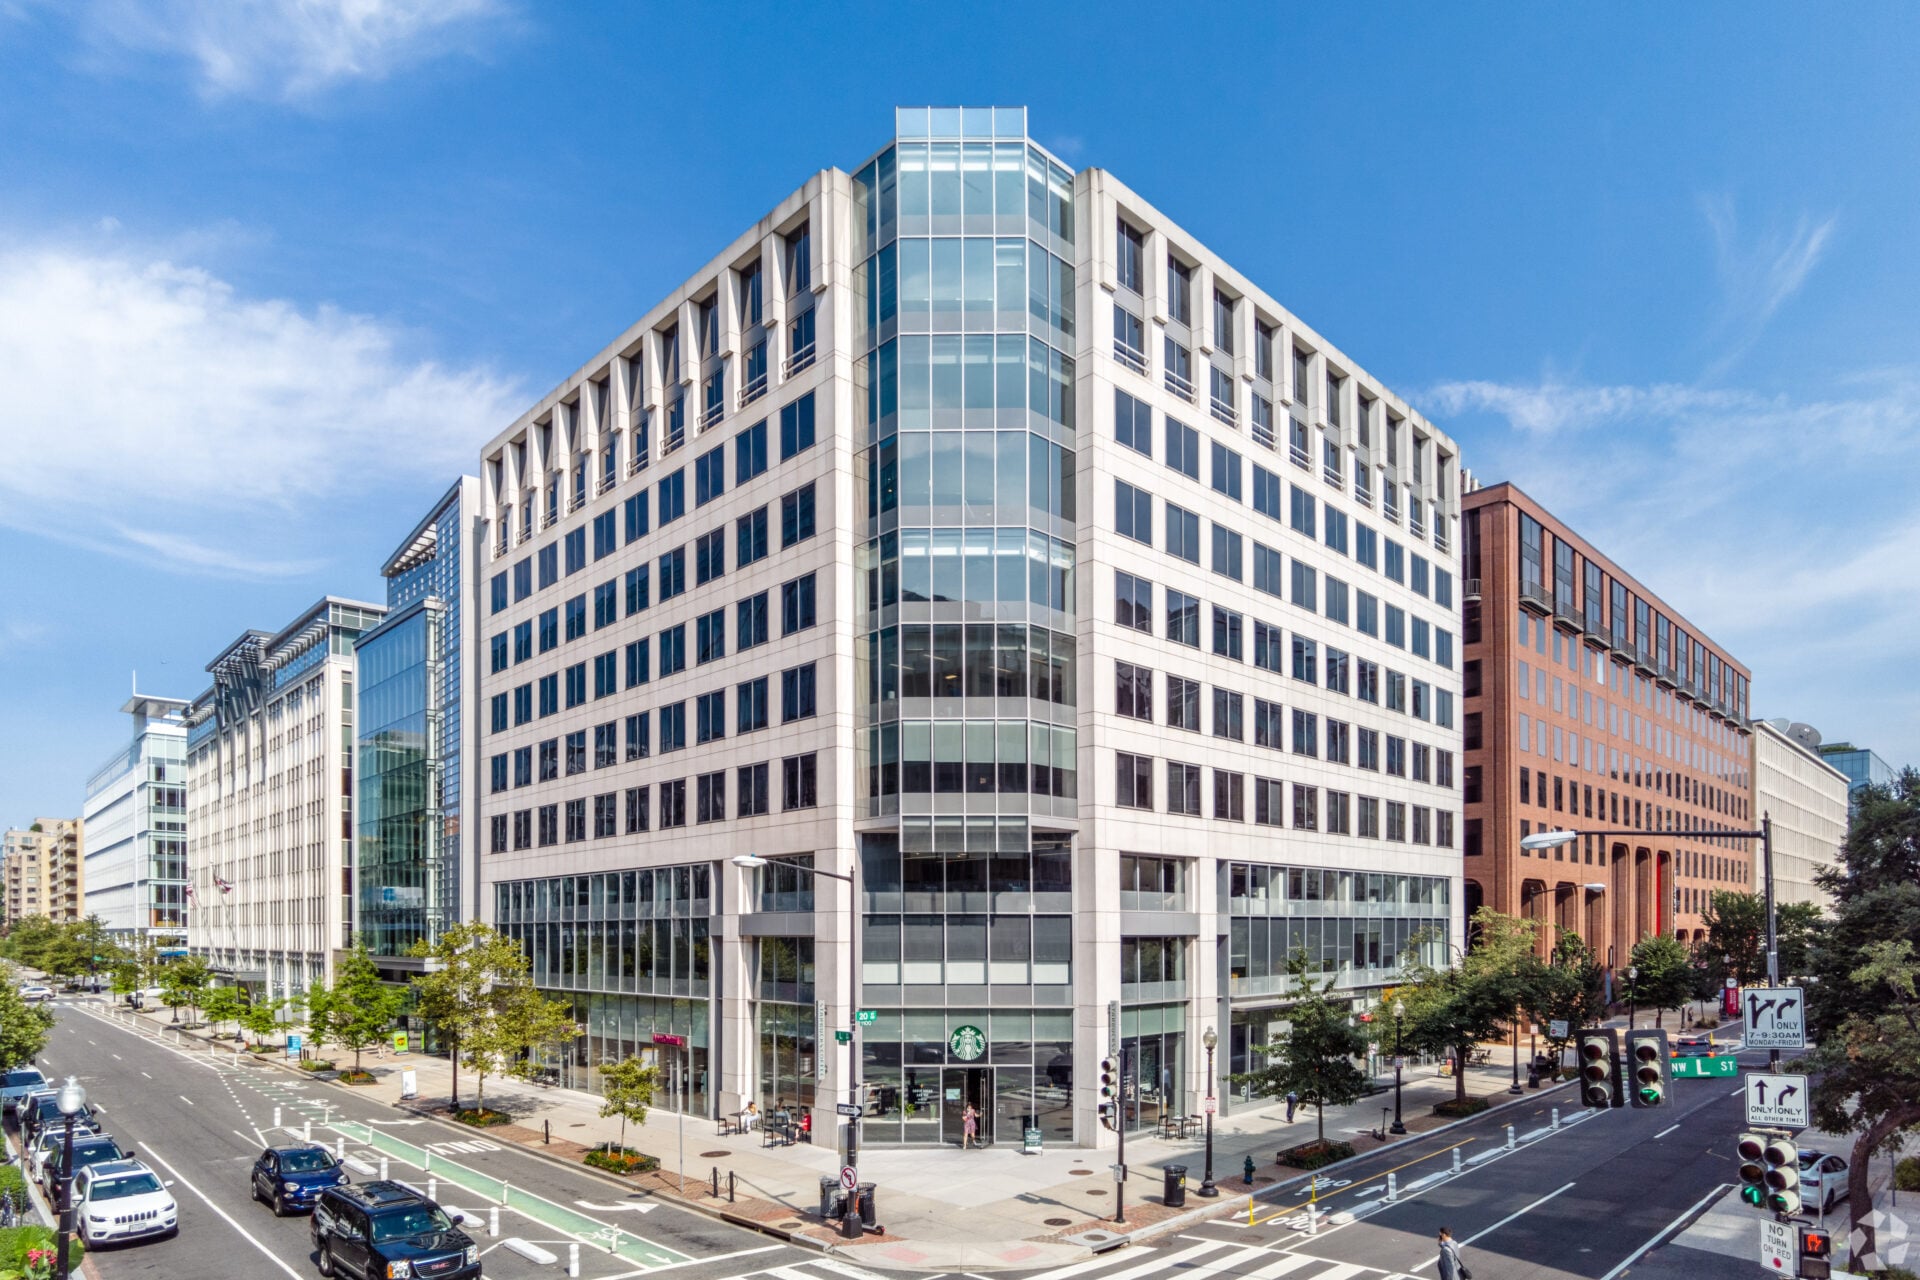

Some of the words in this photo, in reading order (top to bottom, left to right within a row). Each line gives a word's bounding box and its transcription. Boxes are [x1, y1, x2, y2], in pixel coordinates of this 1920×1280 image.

[859, 1012, 868, 1020] 20
[1671, 1063, 1686, 1072] NW
[1696, 1059, 1711, 1075] L
[1721, 1061, 1734, 1071] ST
[1769, 1224, 1784, 1236] NO
[1767, 1236, 1786, 1248] TURN
[1763, 1244, 1774, 1253] ON
[1777, 1249, 1791, 1260] RED
